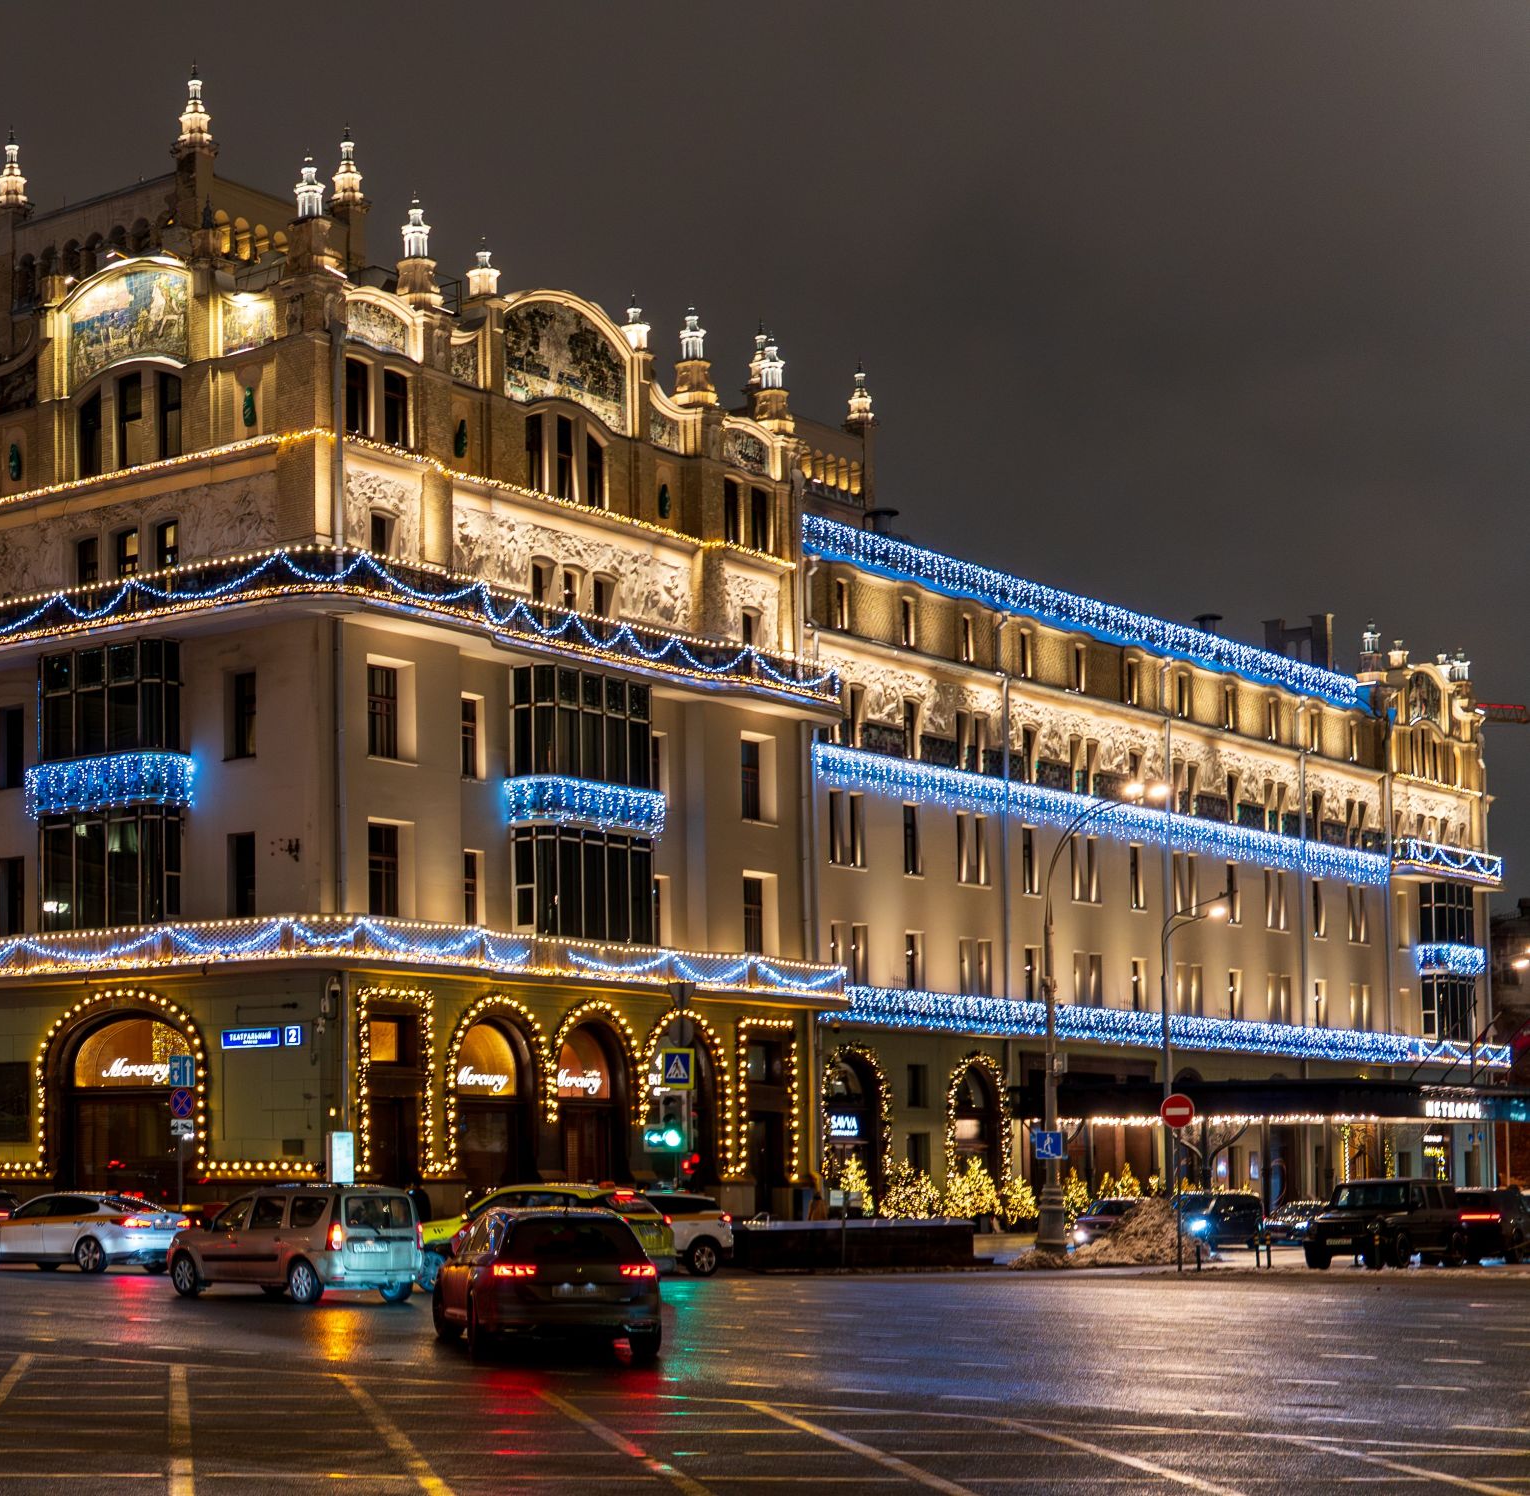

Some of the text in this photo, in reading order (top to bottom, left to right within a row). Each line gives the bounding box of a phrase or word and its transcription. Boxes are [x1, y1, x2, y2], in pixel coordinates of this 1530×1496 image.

[288, 1029, 297, 1043] 2
[101, 1058, 170, 1083] Mercury
[457, 1066, 509, 1093] Mercury
[557, 1069, 603, 1095] Mercury
[1425, 1100, 1482, 1119] METROPOL
[830, 1115, 858, 1129] SAVVA
